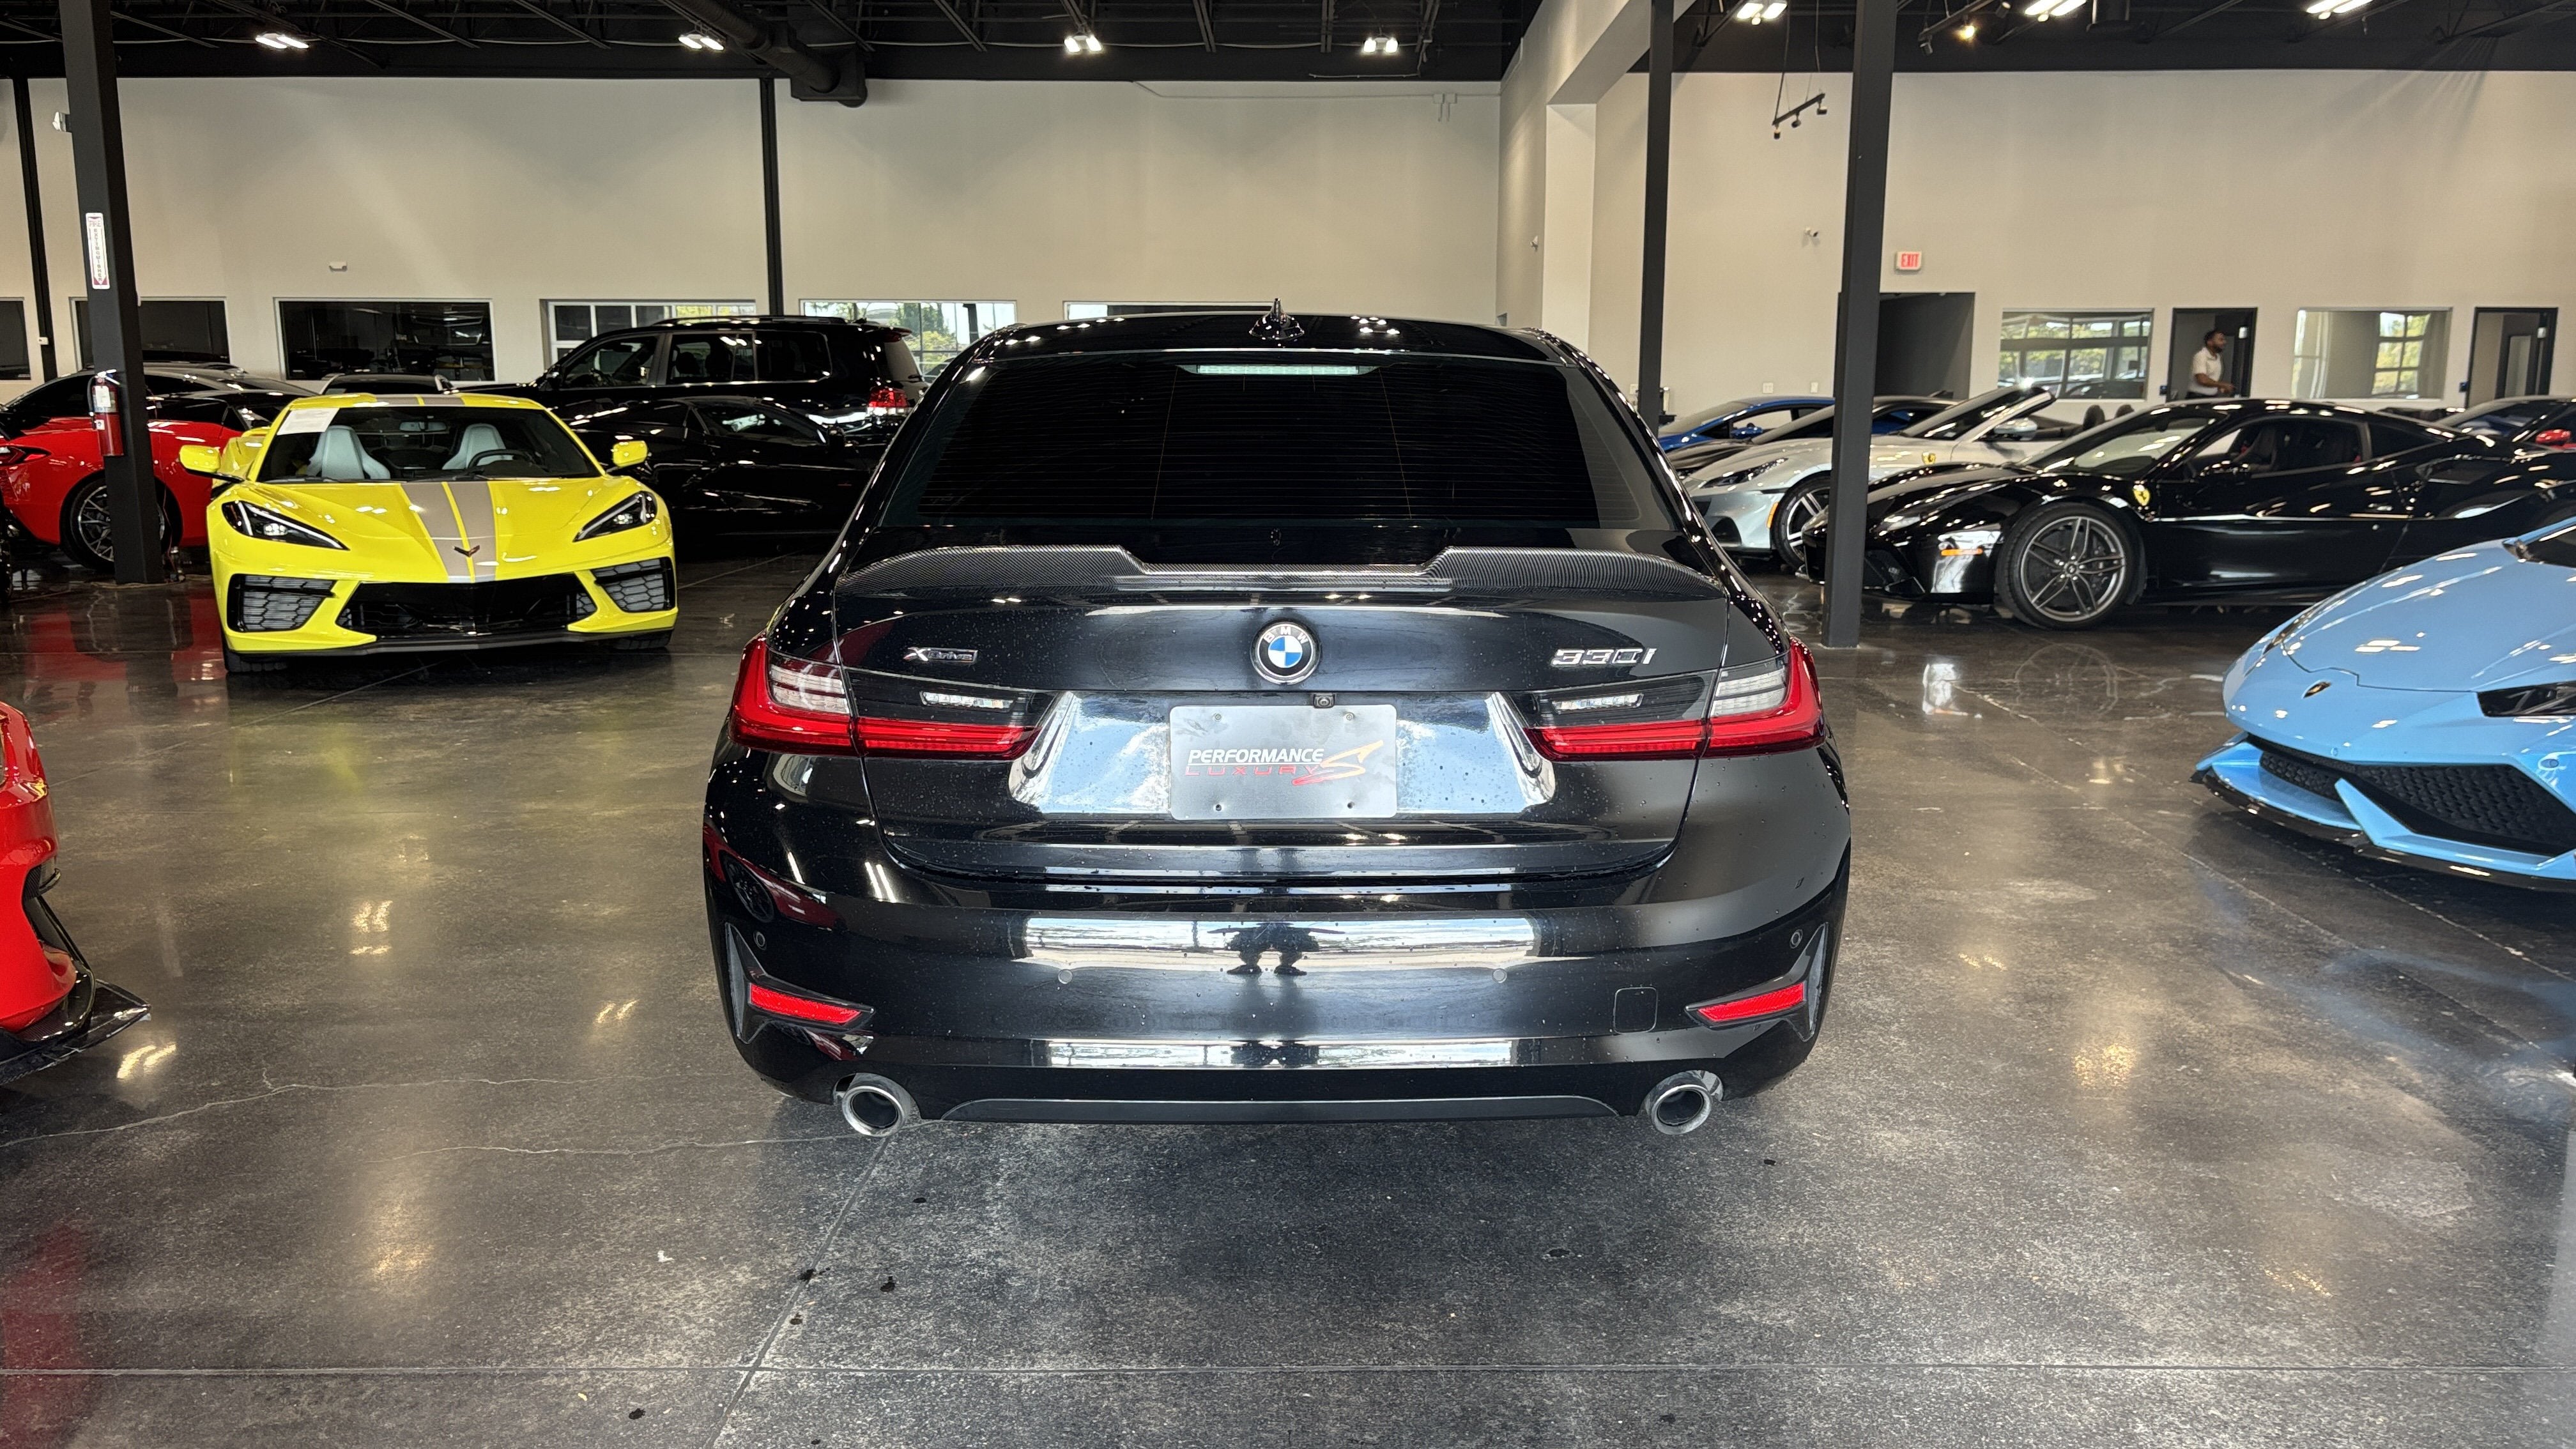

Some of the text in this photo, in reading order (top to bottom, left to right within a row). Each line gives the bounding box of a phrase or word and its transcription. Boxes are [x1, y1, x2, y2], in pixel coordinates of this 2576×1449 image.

[93, 228, 103, 281] EXTINGUISHER
[1901, 254, 1919, 267] EXIT
[1263, 626, 1309, 645] BMW
[1188, 748, 1324, 763] PERFORMANCE
[1184, 765, 1317, 776] LUXURY
